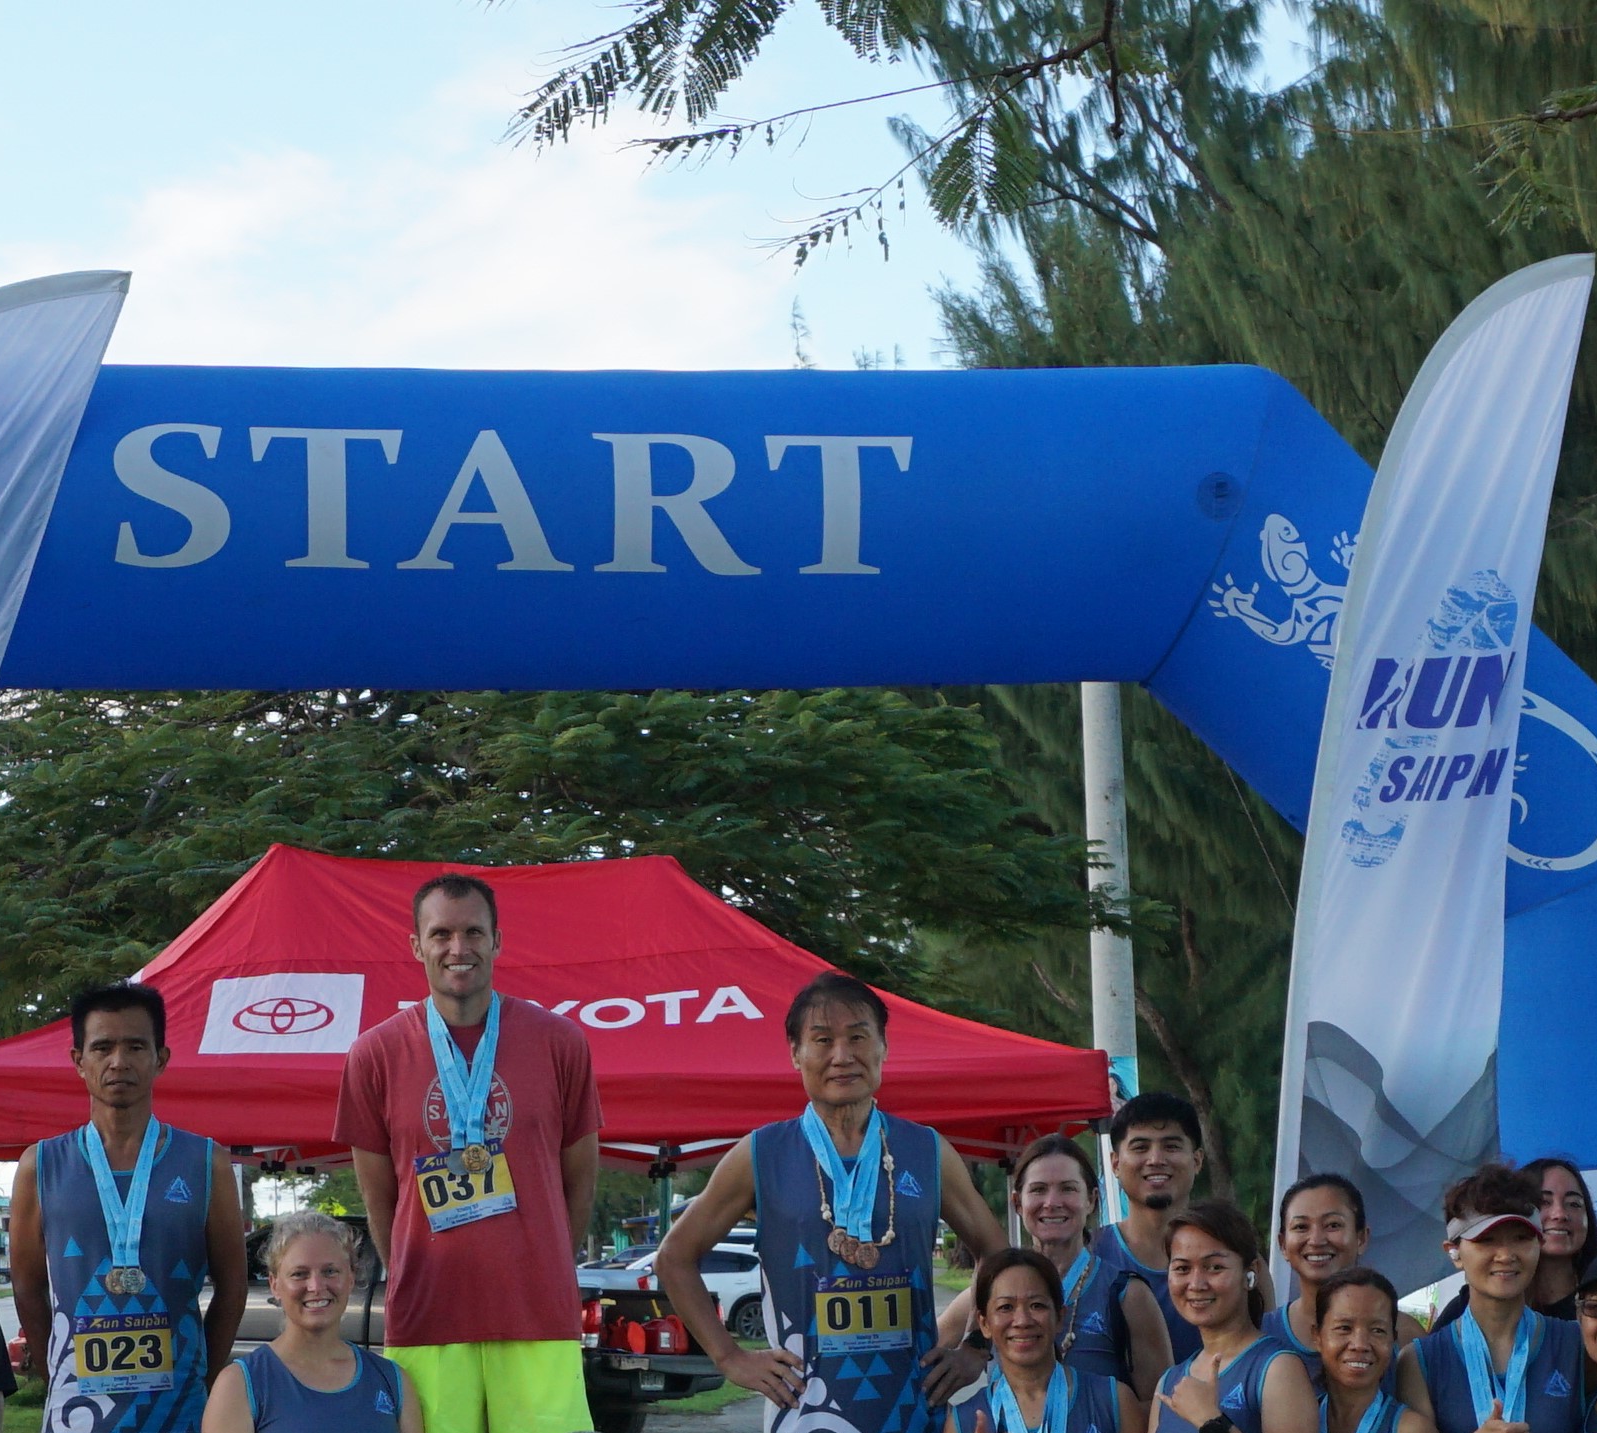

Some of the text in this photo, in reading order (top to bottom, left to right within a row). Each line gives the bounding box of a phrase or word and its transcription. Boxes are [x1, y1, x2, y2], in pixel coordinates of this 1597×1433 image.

[113, 422, 913, 575] START
[1379, 747, 1509, 803] SAIPN
[867, 1275, 908, 1287] Saipan
[125, 1315, 168, 1328] Saipan
[827, 1294, 898, 1331] 011
[85, 1334, 163, 1372] 023
